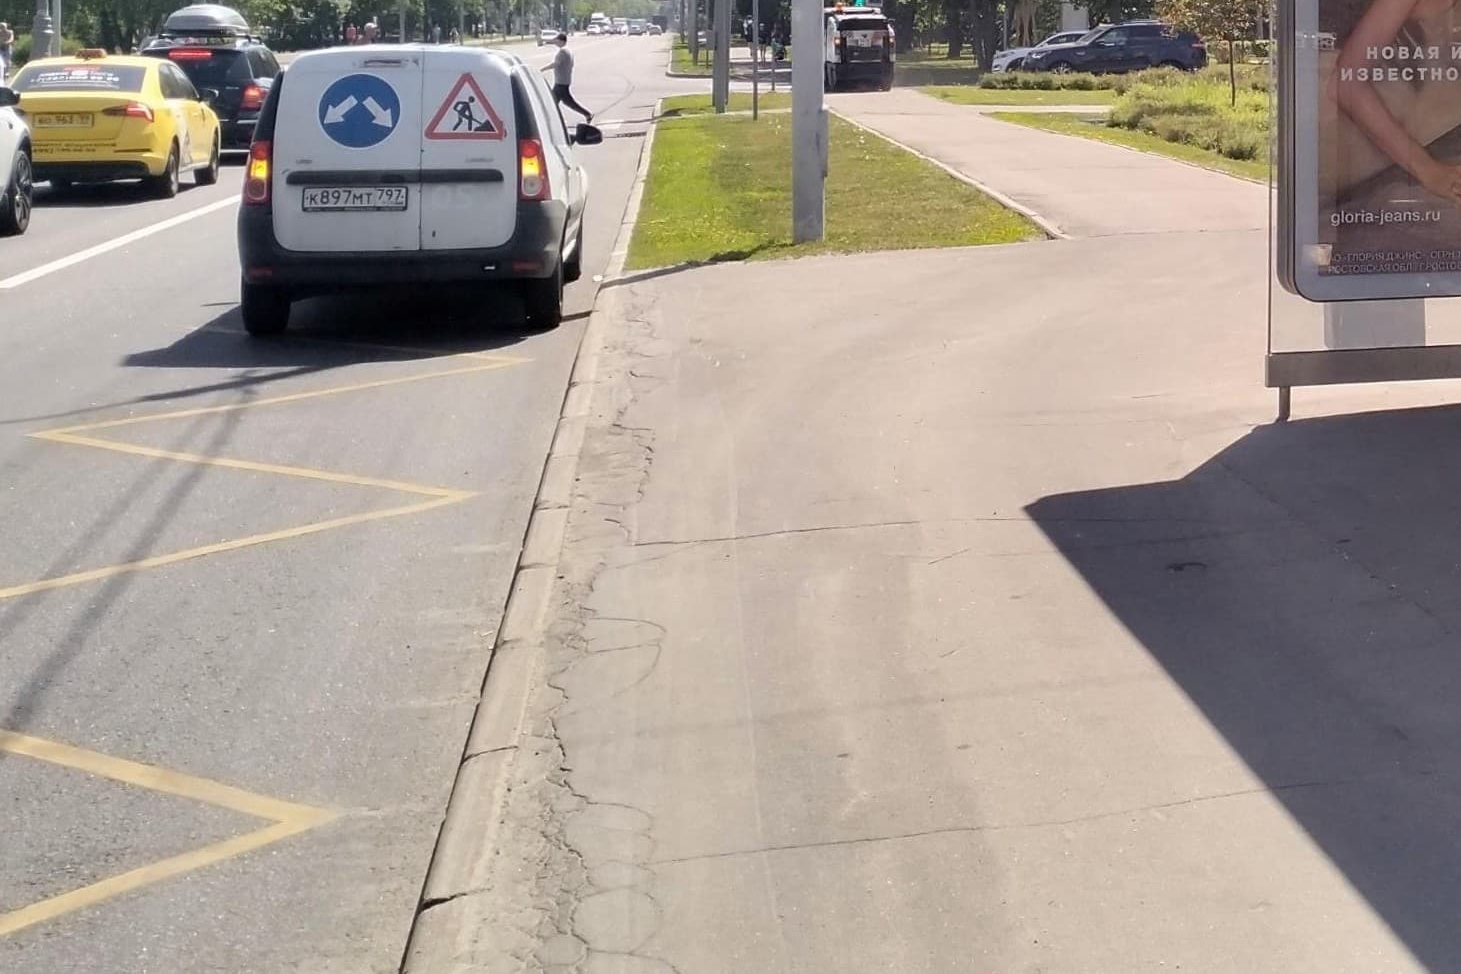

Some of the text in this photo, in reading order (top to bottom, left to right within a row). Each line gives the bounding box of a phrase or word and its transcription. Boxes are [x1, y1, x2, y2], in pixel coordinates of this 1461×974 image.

[1366, 46, 1440, 60] НОВАЯ
[377, 188, 402, 201] 797
[1330, 209, 1441, 226] gloria-jeans.ru
